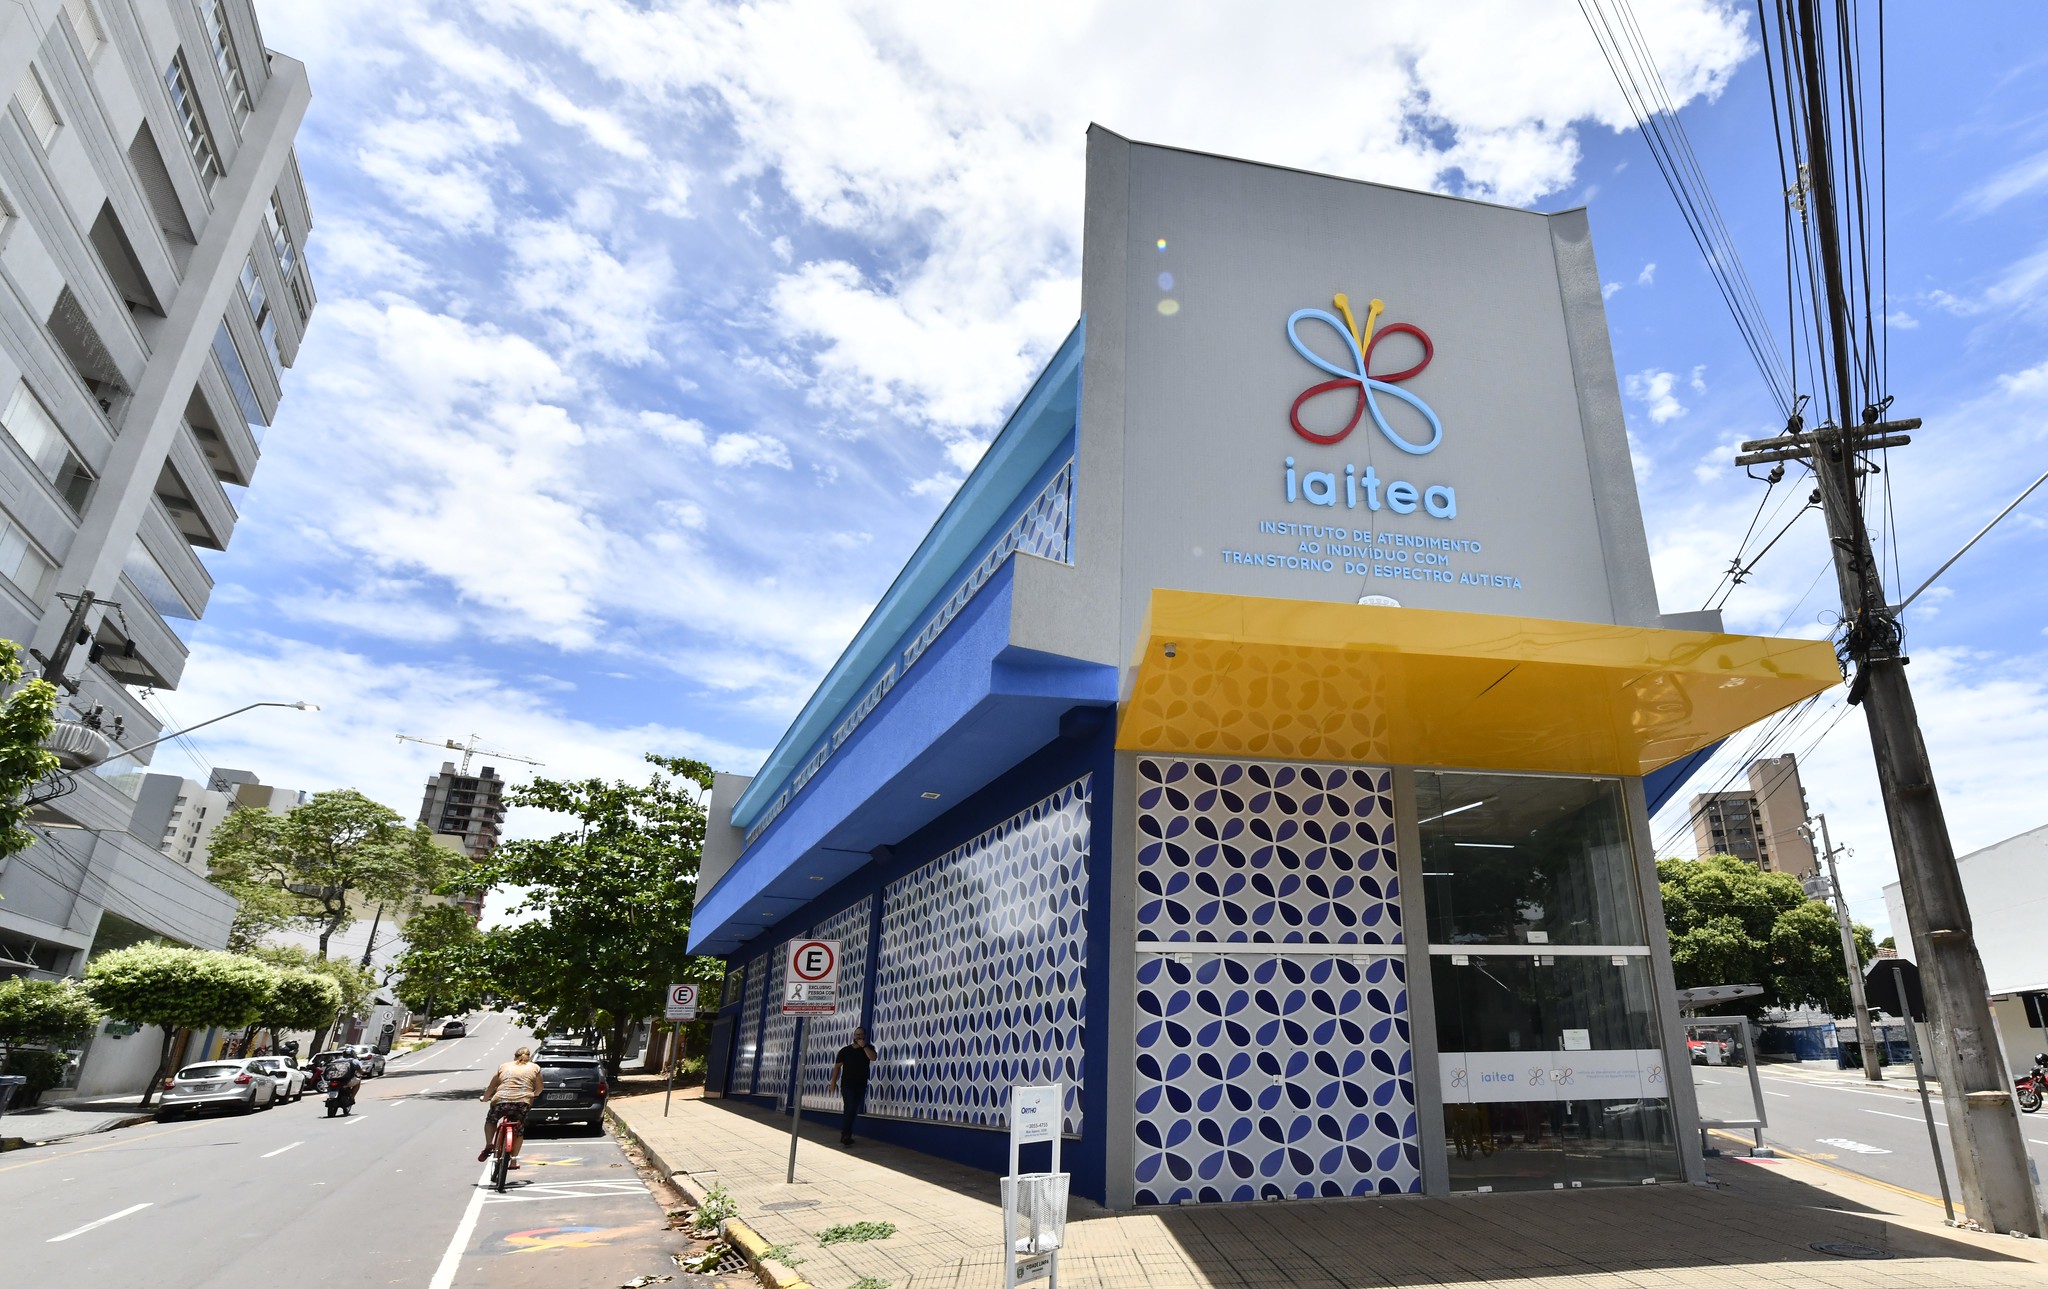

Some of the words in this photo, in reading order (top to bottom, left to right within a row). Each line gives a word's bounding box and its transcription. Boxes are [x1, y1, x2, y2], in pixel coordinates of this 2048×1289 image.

[1285, 456, 1457, 520] iaitea
[1259, 521, 1347, 541] INSTITUTO
[1353, 530, 1371, 543] DE
[1377, 532, 1482, 554] ATENDIMENTO
[1298, 541, 1320, 554] AO
[1326, 543, 1408, 562] INDIVÍDUO
[1414, 551, 1449, 567] COM
[1222, 550, 1334, 572] TRANSTORNO
[1345, 561, 1367, 576] DO
[1374, 565, 1453, 583] ESPECTRO
[1459, 573, 1522, 589] AUTISTA
[806, 951, 822, 971] E
[678, 990, 688, 1001] E
[1481, 1071, 1515, 1083] iaitea
